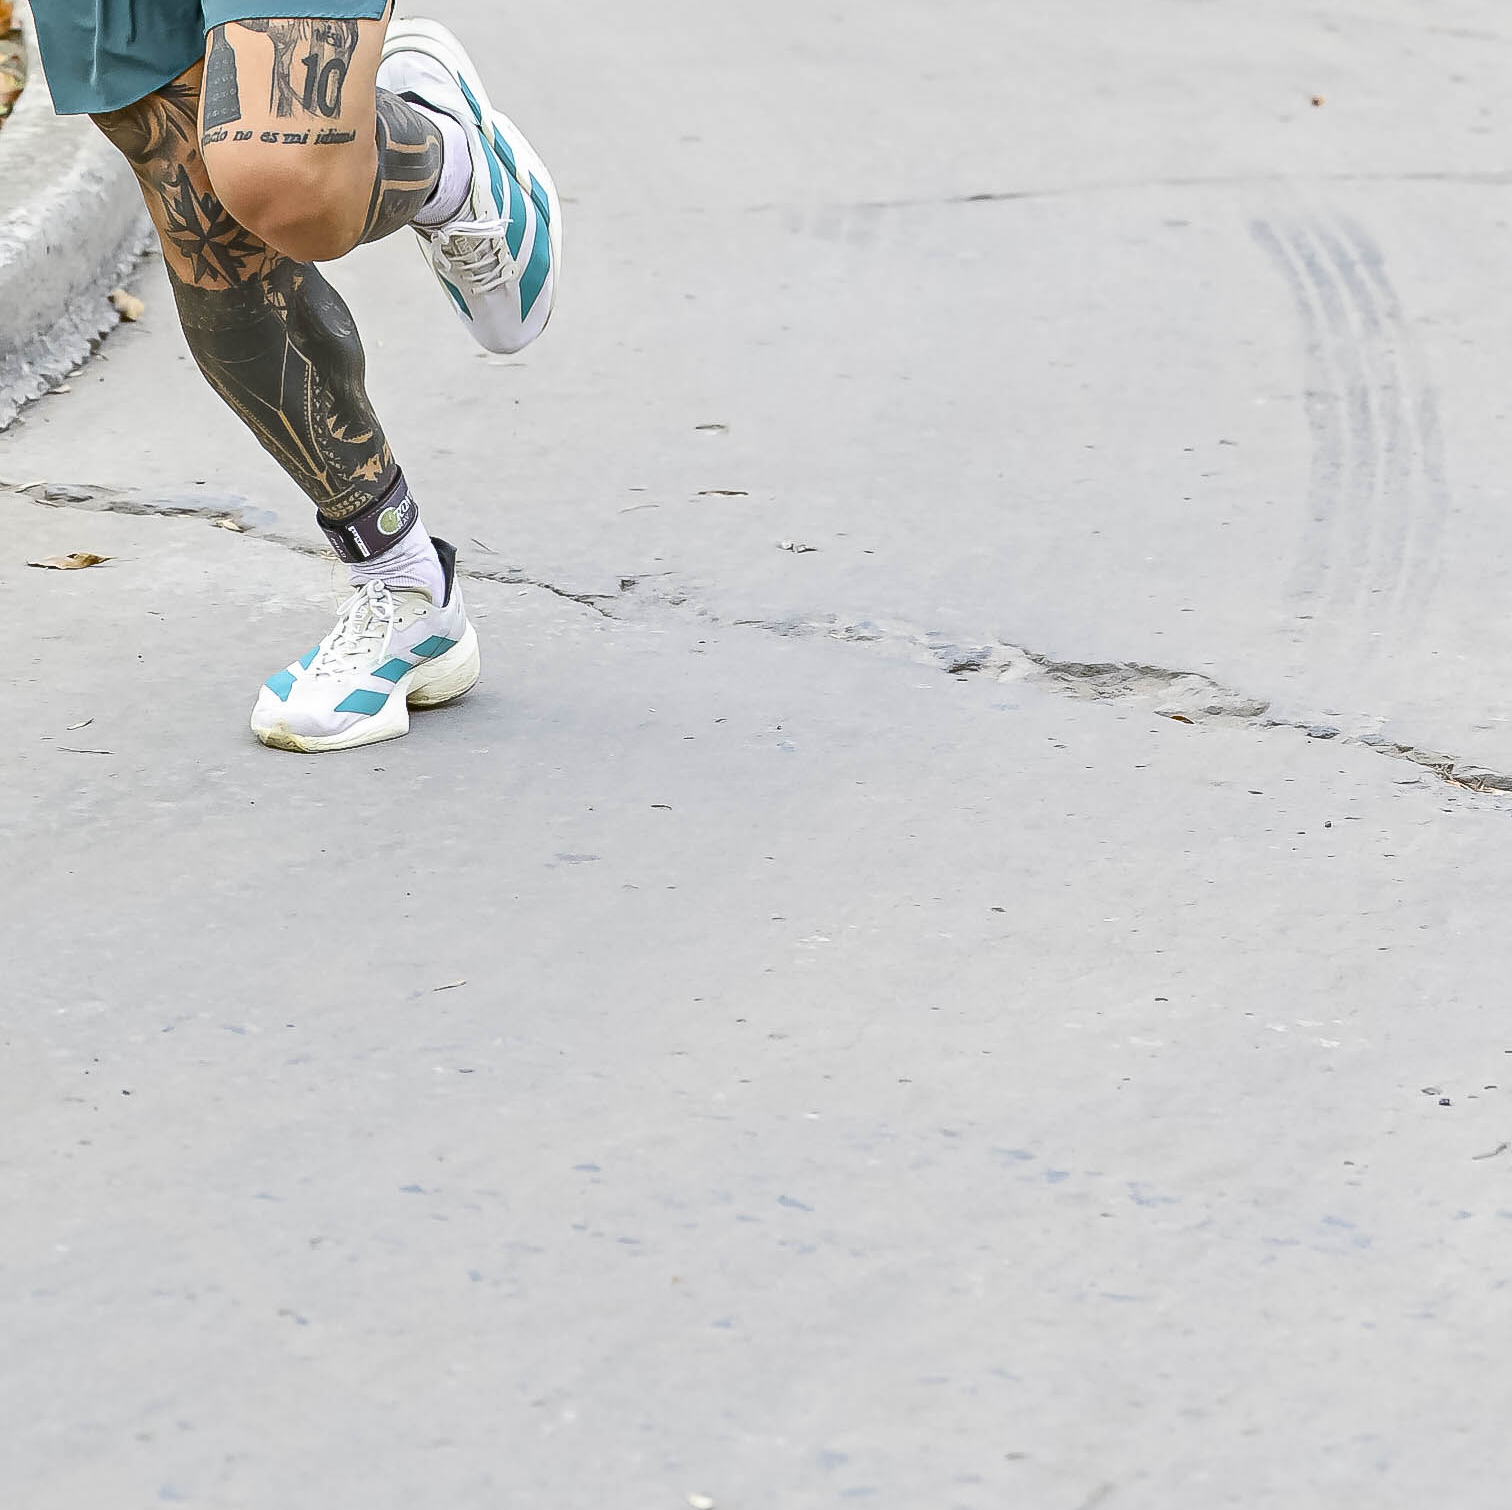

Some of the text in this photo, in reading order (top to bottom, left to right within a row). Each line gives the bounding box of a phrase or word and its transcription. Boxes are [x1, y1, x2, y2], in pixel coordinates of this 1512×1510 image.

[301, 53, 347, 118] 10
[233, 130, 253, 141] no
[260, 130, 279, 143] es
[282, 128, 310, 144] mi
